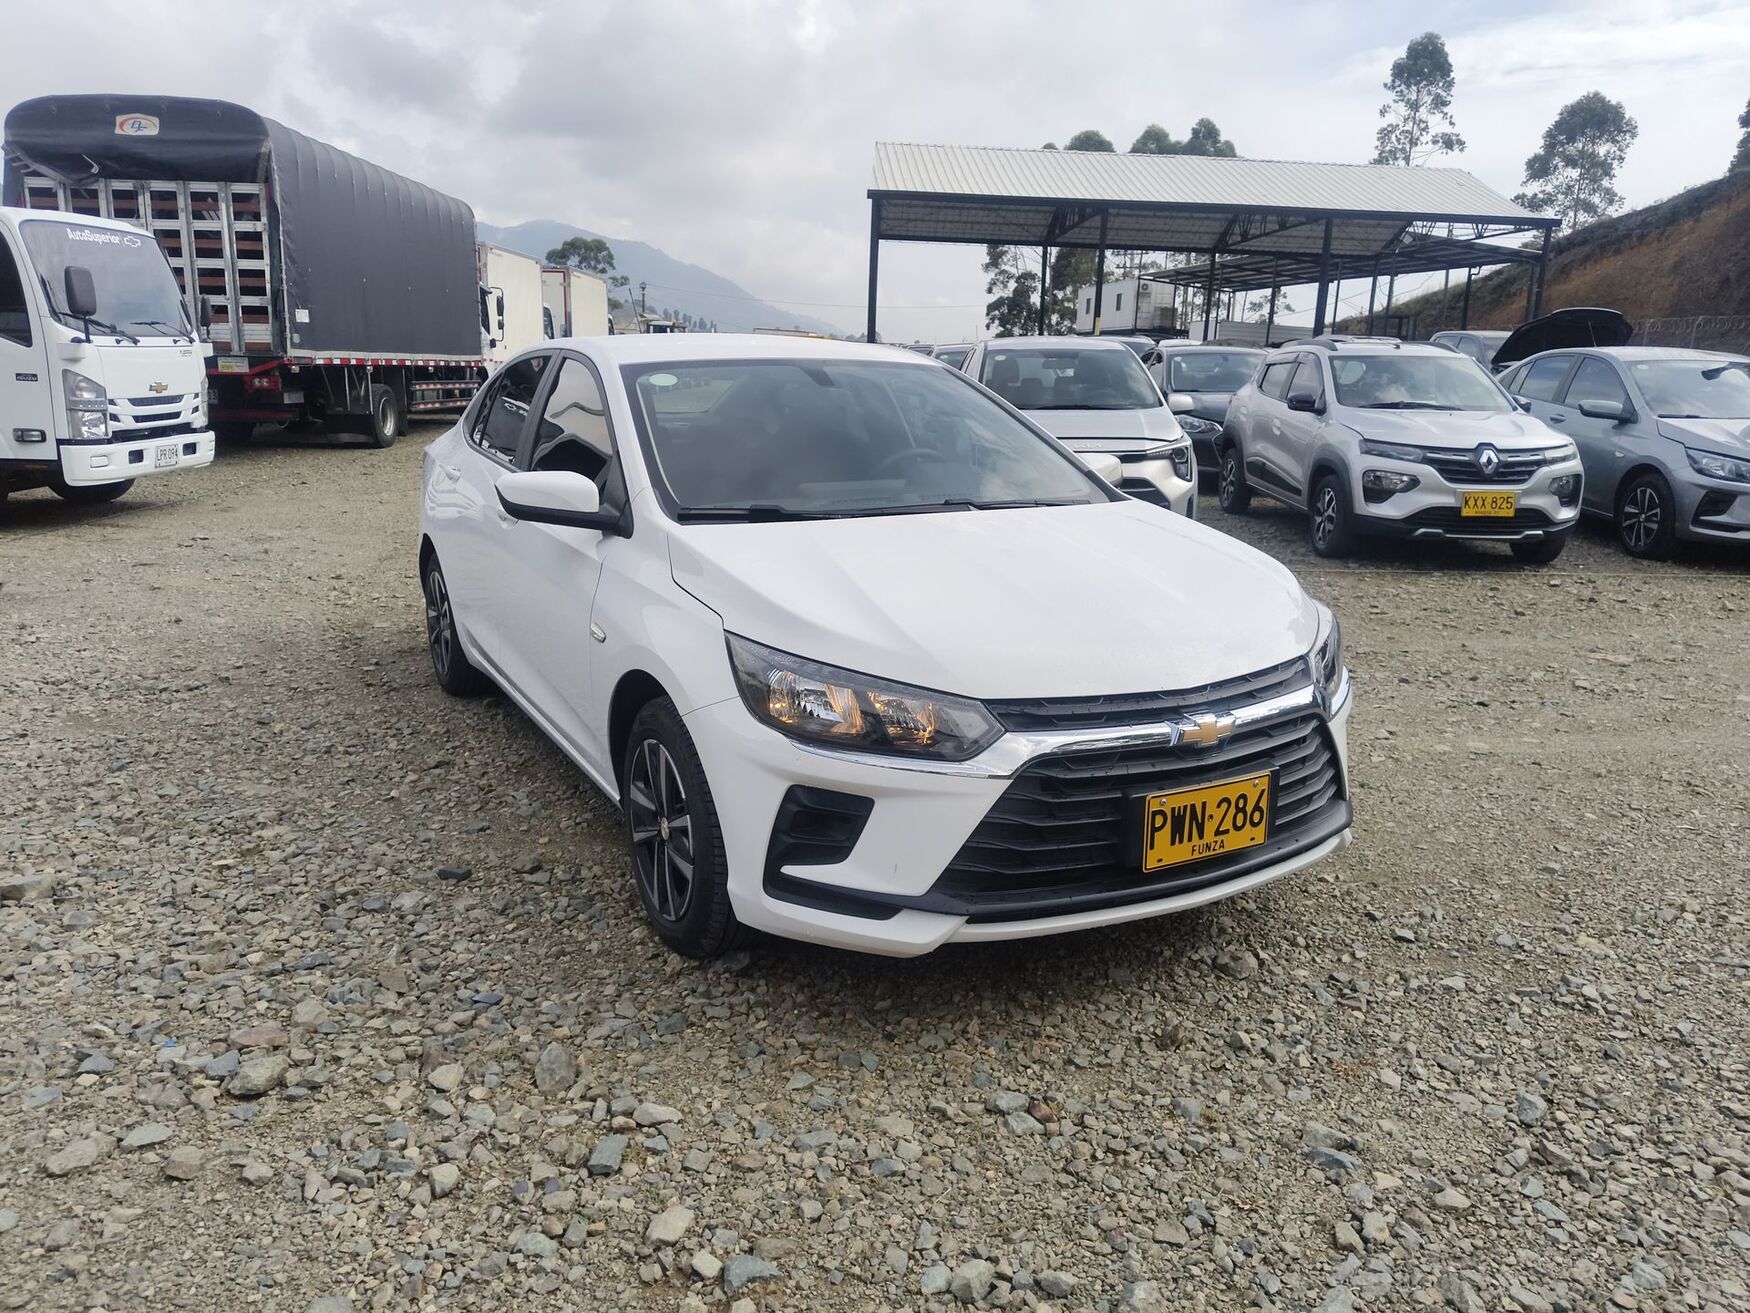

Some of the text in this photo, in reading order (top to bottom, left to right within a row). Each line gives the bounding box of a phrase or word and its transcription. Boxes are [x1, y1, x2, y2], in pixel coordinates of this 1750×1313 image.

[66, 227, 120, 245] AutoSuperior
[1464, 496, 1513, 510] KXX 825
[1191, 839, 1225, 856] FUNZA
